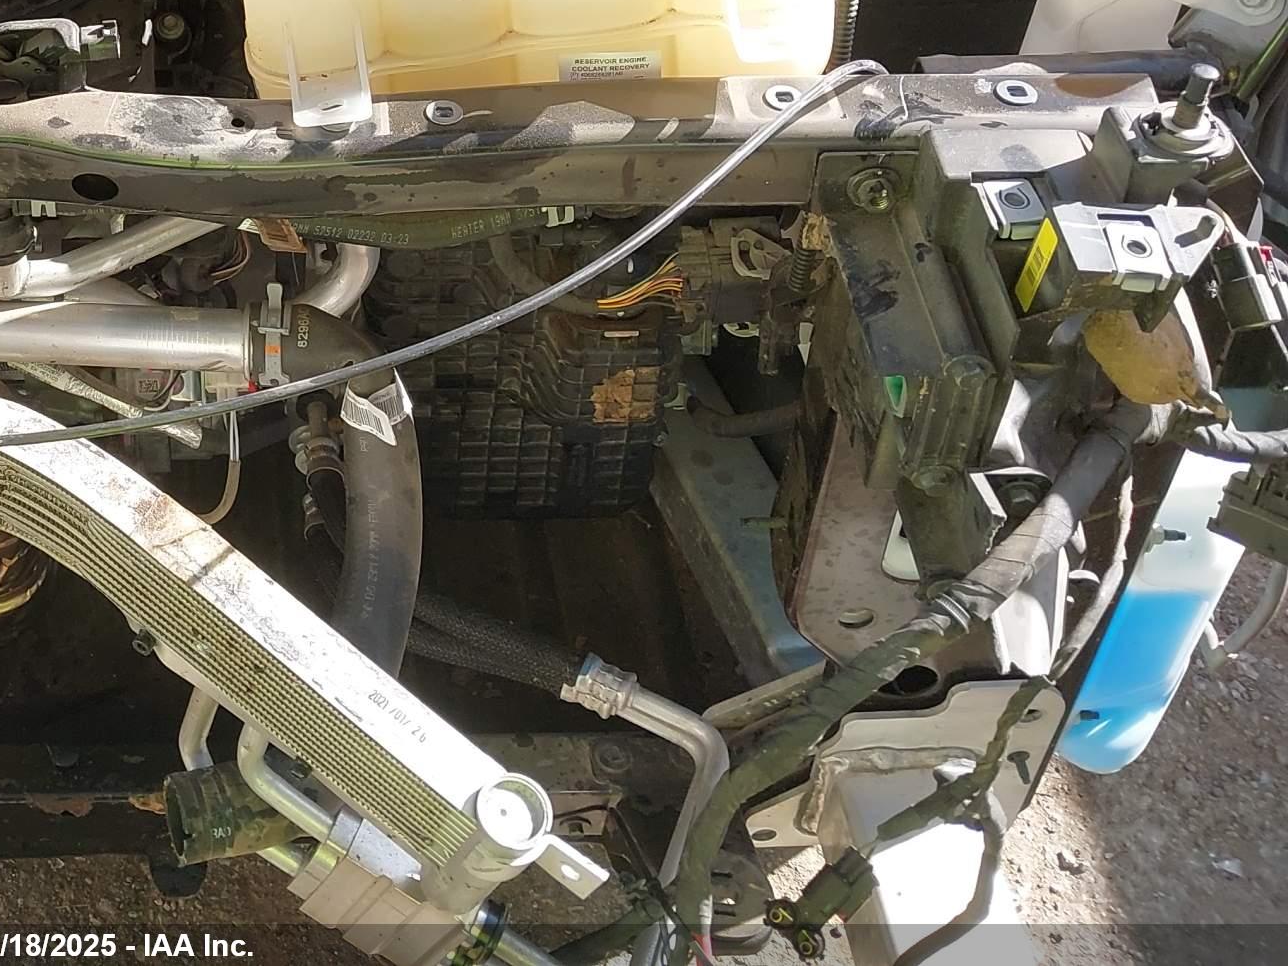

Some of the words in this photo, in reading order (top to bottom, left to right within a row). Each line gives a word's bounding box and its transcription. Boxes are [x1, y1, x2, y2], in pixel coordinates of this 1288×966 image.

[619, 56, 647, 64] ENGINE
[571, 65, 608, 73] COOLANT
[609, 62, 650, 71] RECOVERY
